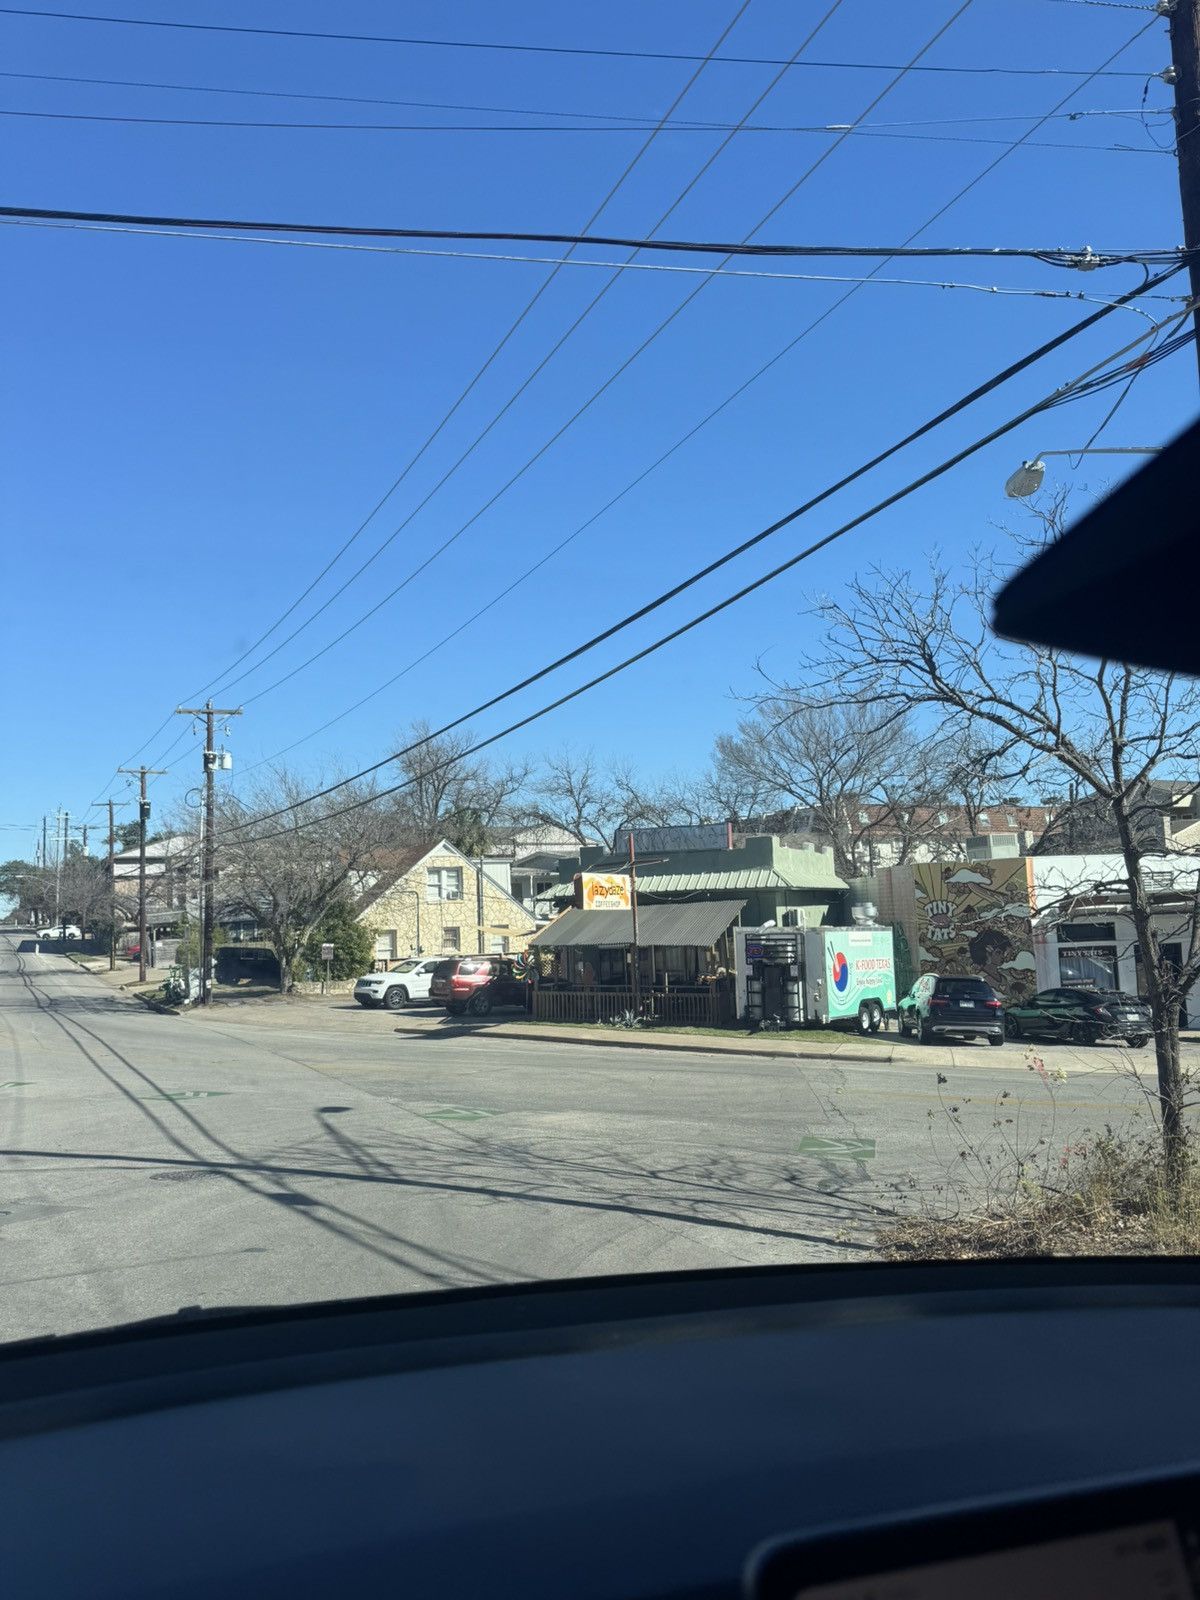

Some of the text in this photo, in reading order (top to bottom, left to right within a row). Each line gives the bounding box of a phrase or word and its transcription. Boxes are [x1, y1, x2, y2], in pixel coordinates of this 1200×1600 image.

[592, 882, 624, 898] lazydaze
[924, 900, 957, 918] TINY
[927, 924, 956, 941] TATS
[856, 959, 875, 970] K-FOOD
